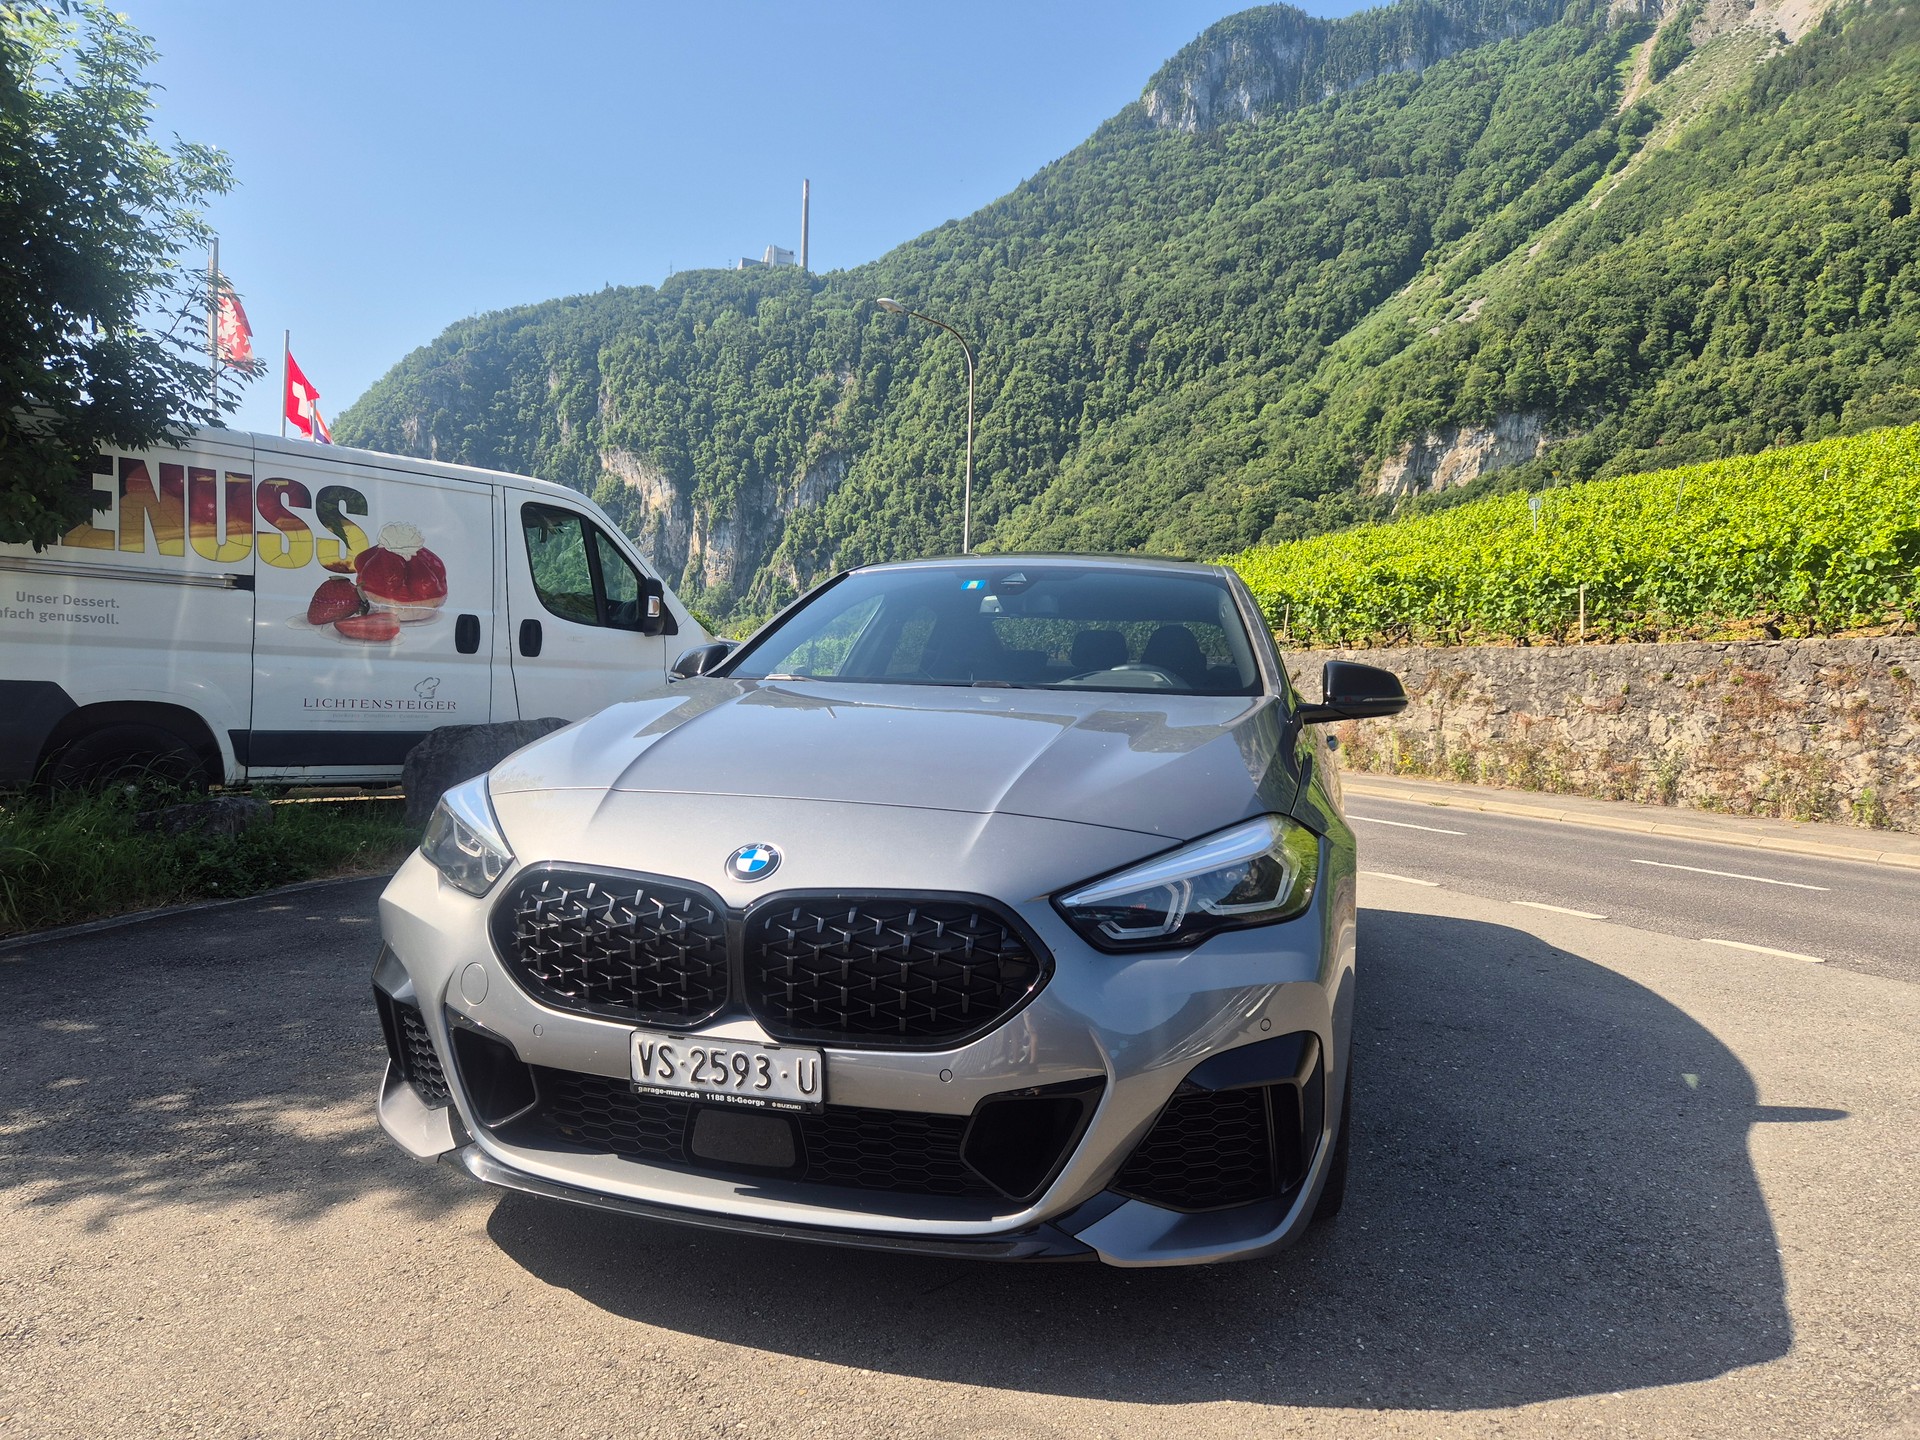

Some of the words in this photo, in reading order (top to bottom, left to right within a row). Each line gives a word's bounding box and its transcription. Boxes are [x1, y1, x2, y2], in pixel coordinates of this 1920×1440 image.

[55, 454, 370, 574] ENUSS
[16, 591, 58, 604] Unser
[63, 594, 119, 608] Dessert.
[39, 611, 119, 625] genussvoll.
[303, 697, 457, 710] LICHTENSTEIGER
[738, 843, 778, 856] BMW
[637, 1086, 700, 1099] garage-muret.ch
[726, 1095, 765, 1106] St-George
